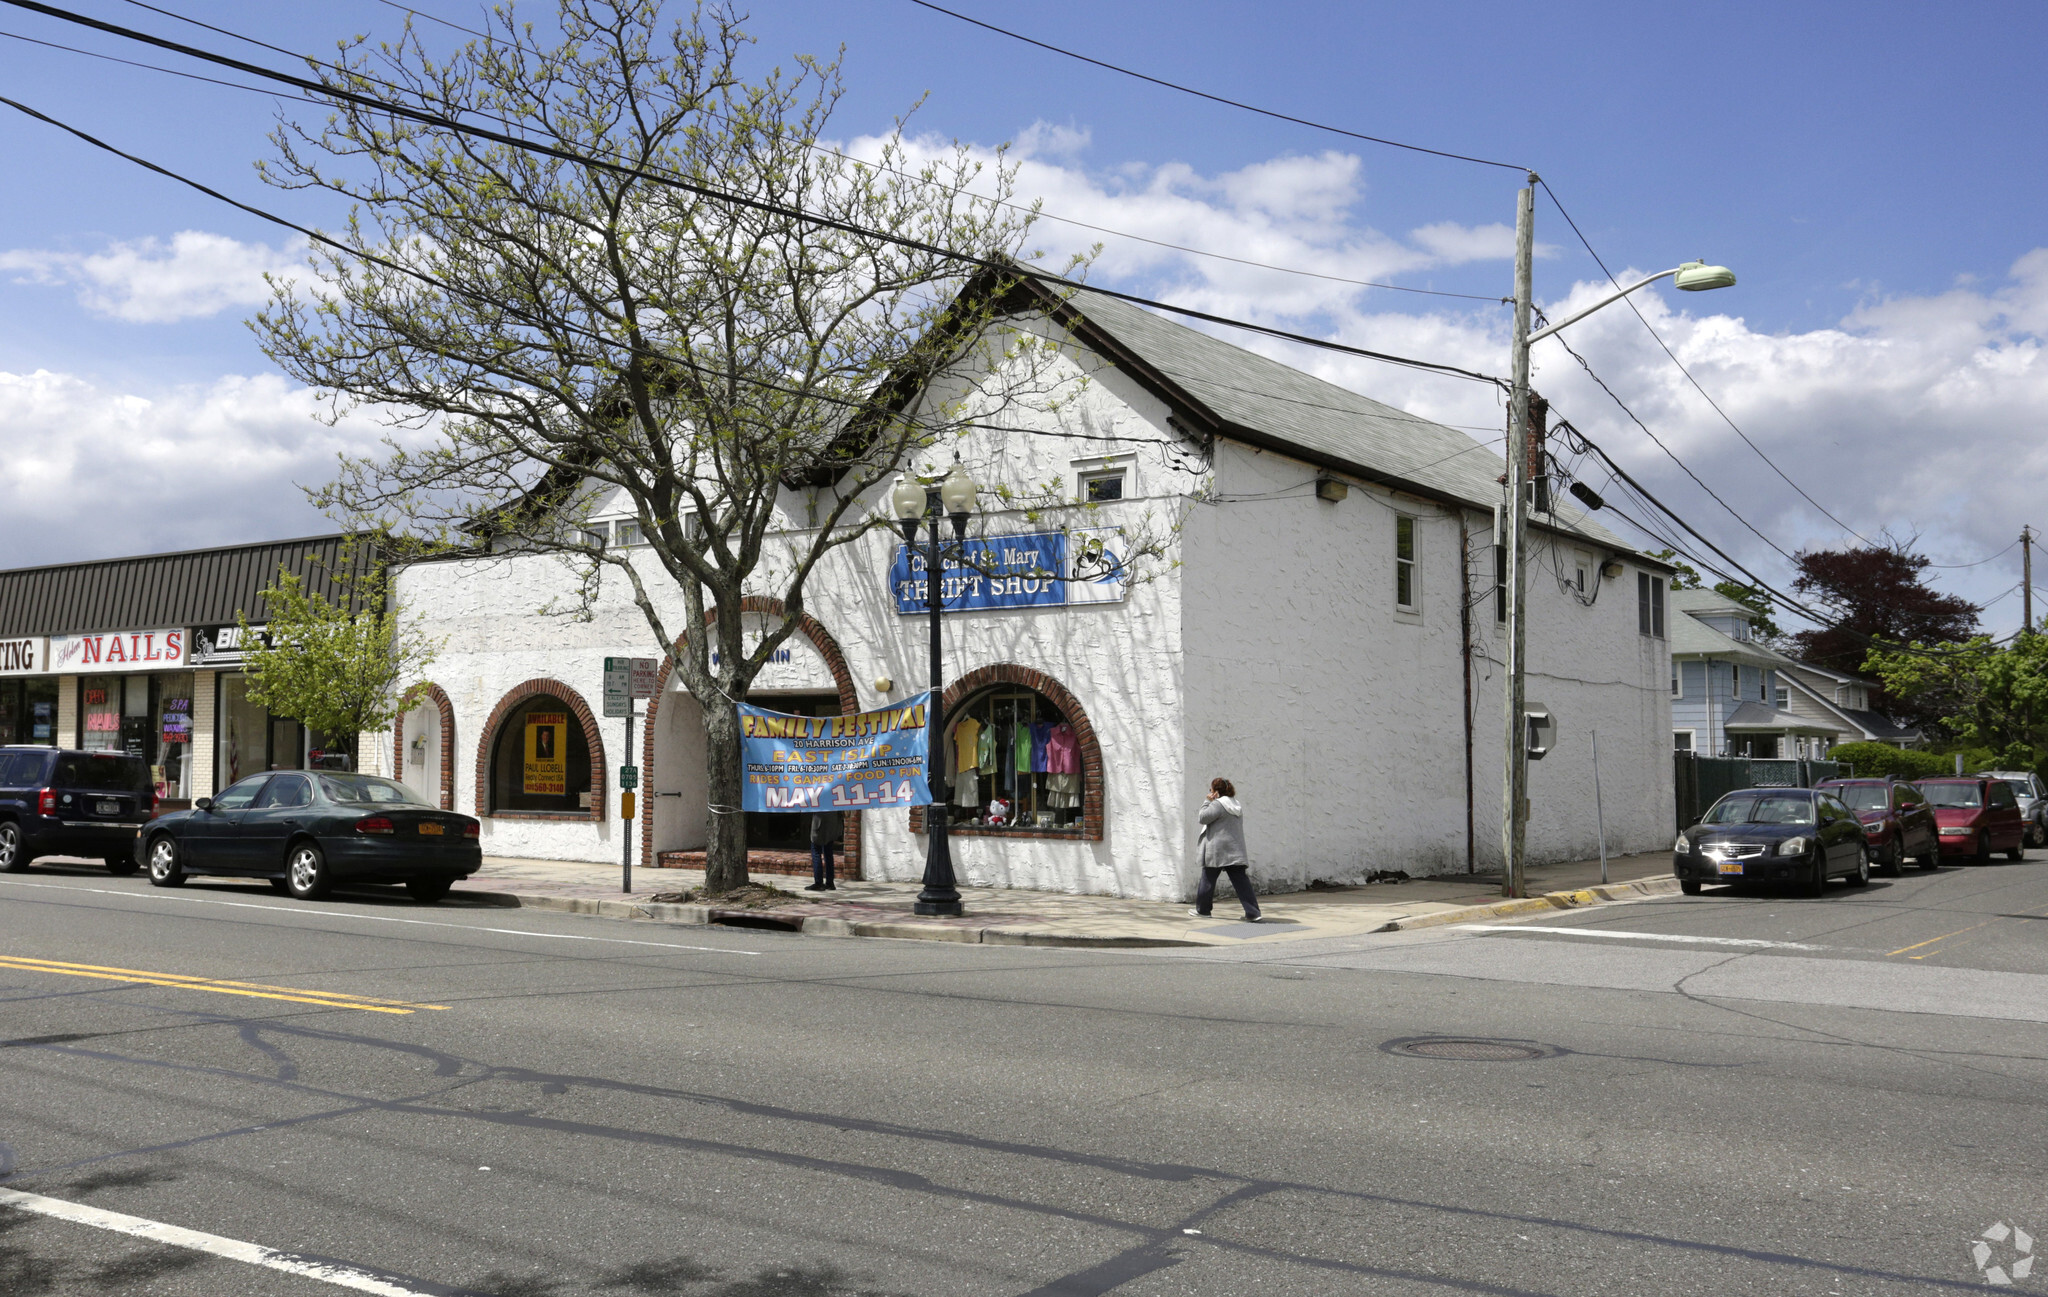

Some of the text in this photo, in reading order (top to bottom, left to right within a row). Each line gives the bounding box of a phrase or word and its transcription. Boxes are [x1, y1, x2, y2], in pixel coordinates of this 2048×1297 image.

[1003, 547, 1039, 568] Mary
[990, 572, 1056, 596] SHOP
[81, 629, 183, 663] NAILS
[632, 669, 655, 678] PARKING
[639, 661, 650, 669] NO
[84, 689, 105, 705] OPEN
[169, 699, 189, 711] SPA
[87, 713, 120, 731] NAILS
[527, 713, 565, 725] AVAILABLE
[741, 703, 926, 738] FAMILY FESTIVAL
[794, 736, 875, 748] 20 HARRISON AVE
[772, 744, 892, 763] EAST ISLIP
[525, 763, 564, 774] PAUL LLOBELL
[749, 767, 922, 784] RIDES GAMES FOOD FUN
[765, 779, 914, 808] MAY 11-14
